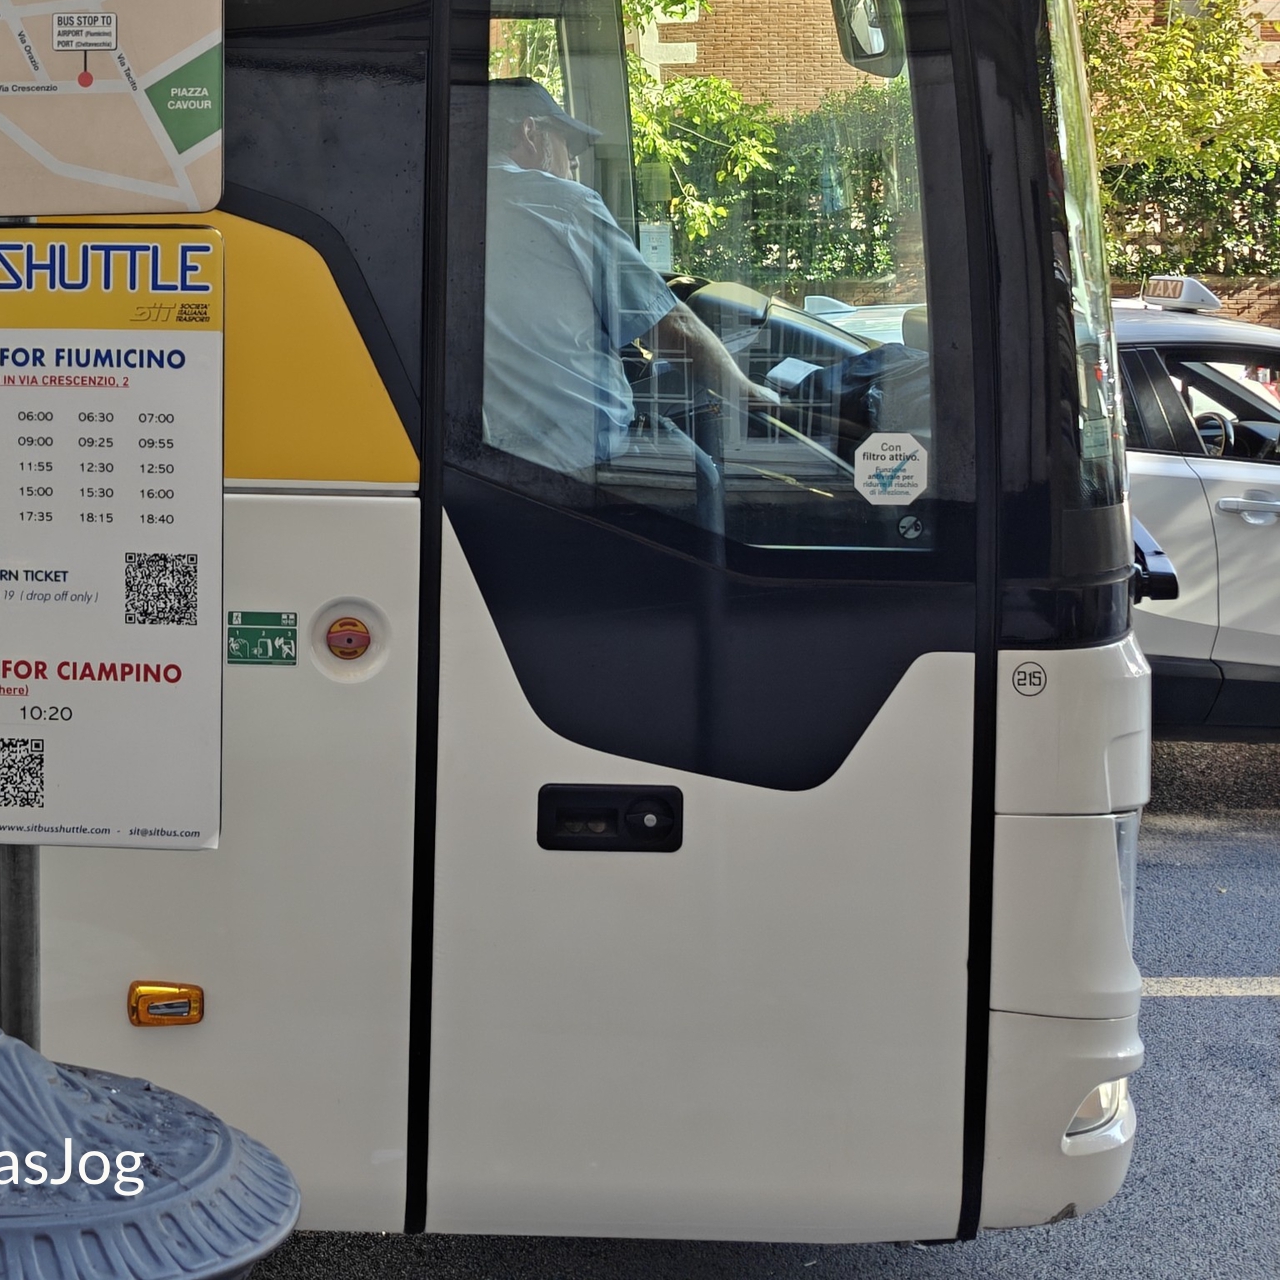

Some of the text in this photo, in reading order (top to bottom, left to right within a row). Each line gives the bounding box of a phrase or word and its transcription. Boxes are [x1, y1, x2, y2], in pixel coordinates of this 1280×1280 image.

[57, 16, 112, 25] BUS STOP TO
[17, 30, 39, 71] Via Orazio
[117, 53, 138, 91] Via Tacito
[12, 84, 58, 92] Crescenzio
[171, 87, 209, 97] PIAZZA
[167, 100, 212, 110] CAVOUR
[1147, 281, 1182, 297] TAXI
[0, 348, 45, 367] FOR
[56, 349, 185, 369] FIUMICINO
[4, 375, 15, 385] IN
[19, 375, 39, 385] VIA
[42, 375, 120, 386] CRESCENZIO,
[123, 376, 130, 386] 2
[18, 412, 53, 421] 06:00
[79, 412, 114, 422] 06:30
[139, 413, 174, 423] 07:00
[18, 437, 53, 446] 09:00
[78, 437, 113, 447] 09:25
[139, 439, 173, 448] 09:55
[881, 442, 901, 451] Con
[862, 452, 920, 461] filtro attivo.
[20, 462, 52, 471] 11:55
[80, 463, 114, 472] 12:30
[140, 464, 174, 473] 12:50
[20, 487, 53, 496] 15:00
[80, 488, 113, 498] 15:30
[140, 489, 174, 499] 16:00
[20, 512, 52, 521] 17:35
[80, 513, 113, 523] 18:15
[140, 514, 174, 524] 18:40
[23, 570, 68, 582] TICKET
[5, 590, 14, 600] 19
[26, 591, 51, 603] drop
[54, 591, 68, 601] off
[70, 591, 92, 604] only
[2, 660, 48, 679] FOR
[57, 661, 181, 683] CIAMPINO
[1017, 671, 1042, 686] 215
[0, 685, 29, 695] here)
[21, 706, 72, 721] 10:20
[0, 824, 110, 834] www.sitbusshuttle.com
[129, 827, 200, 837] sit@sitbus.com
